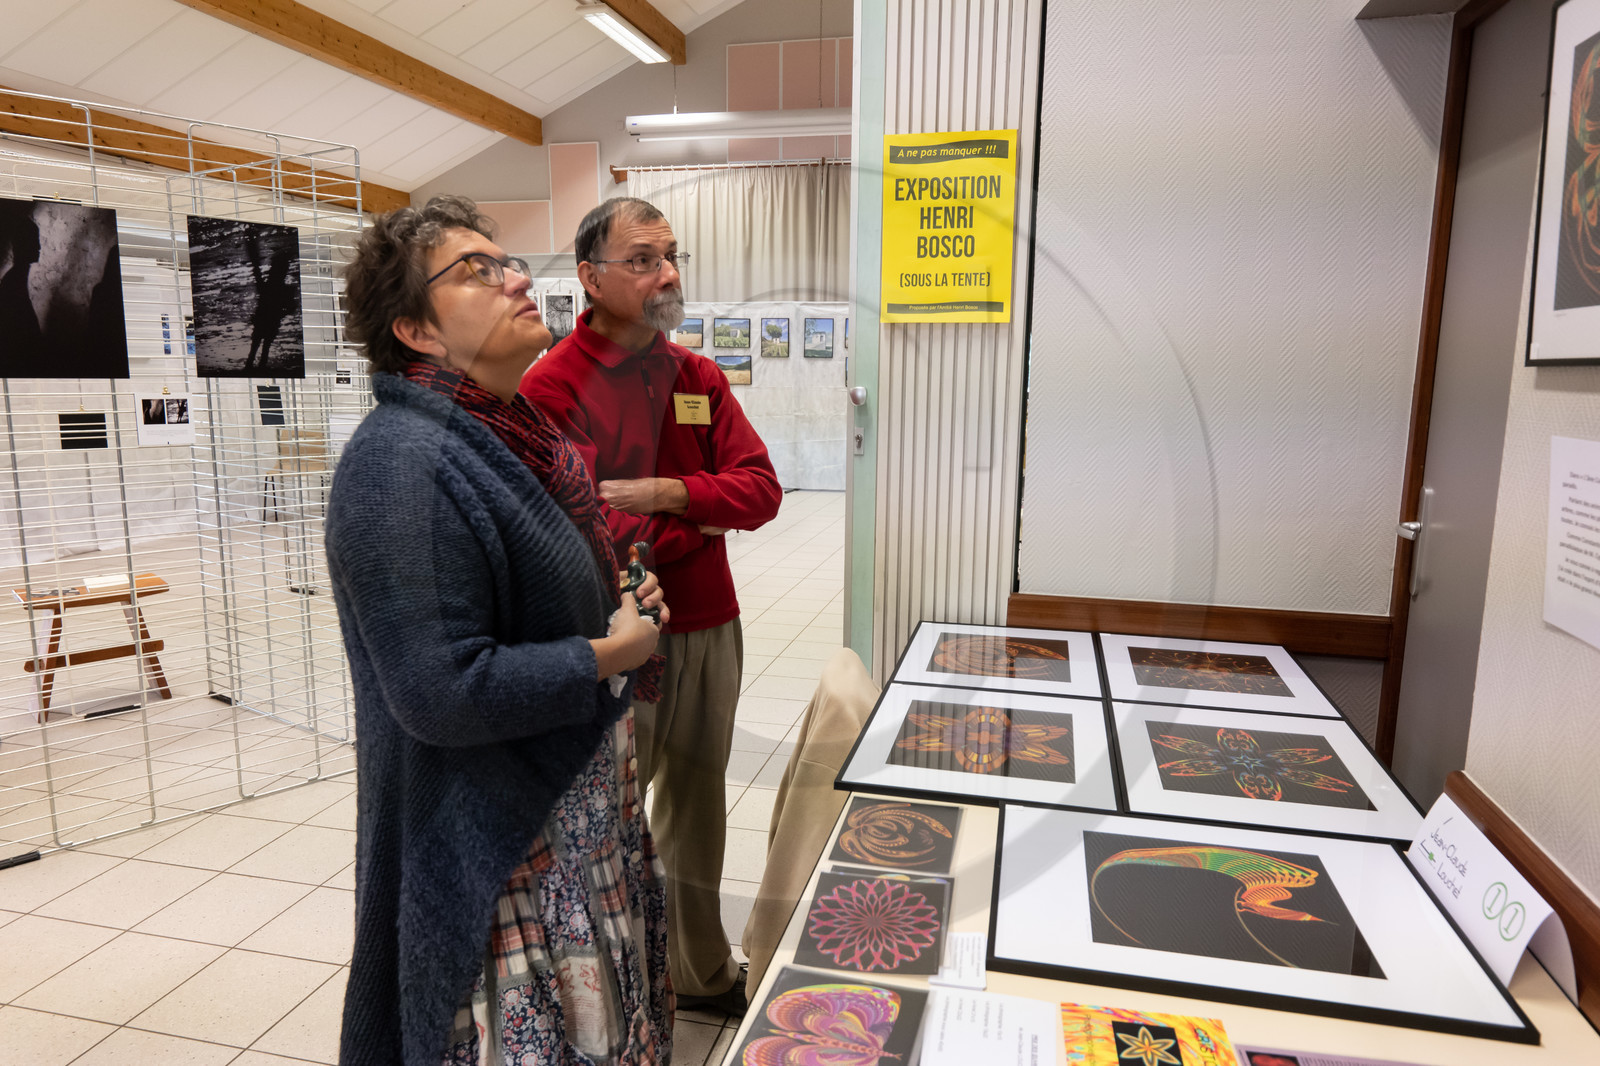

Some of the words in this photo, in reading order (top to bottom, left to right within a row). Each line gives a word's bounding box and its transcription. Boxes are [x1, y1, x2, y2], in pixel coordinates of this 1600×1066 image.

[897, 148, 905, 158] A
[906, 150, 918, 158] ne
[920, 148, 937, 159] pas
[940, 145, 983, 158] manquer
[985, 144, 997, 155] !!!
[894, 175, 1002, 201] EXPOSITION
[919, 205, 974, 230] HENRI
[916, 235, 976, 259] BOSCO
[935, 273, 948, 287] LA
